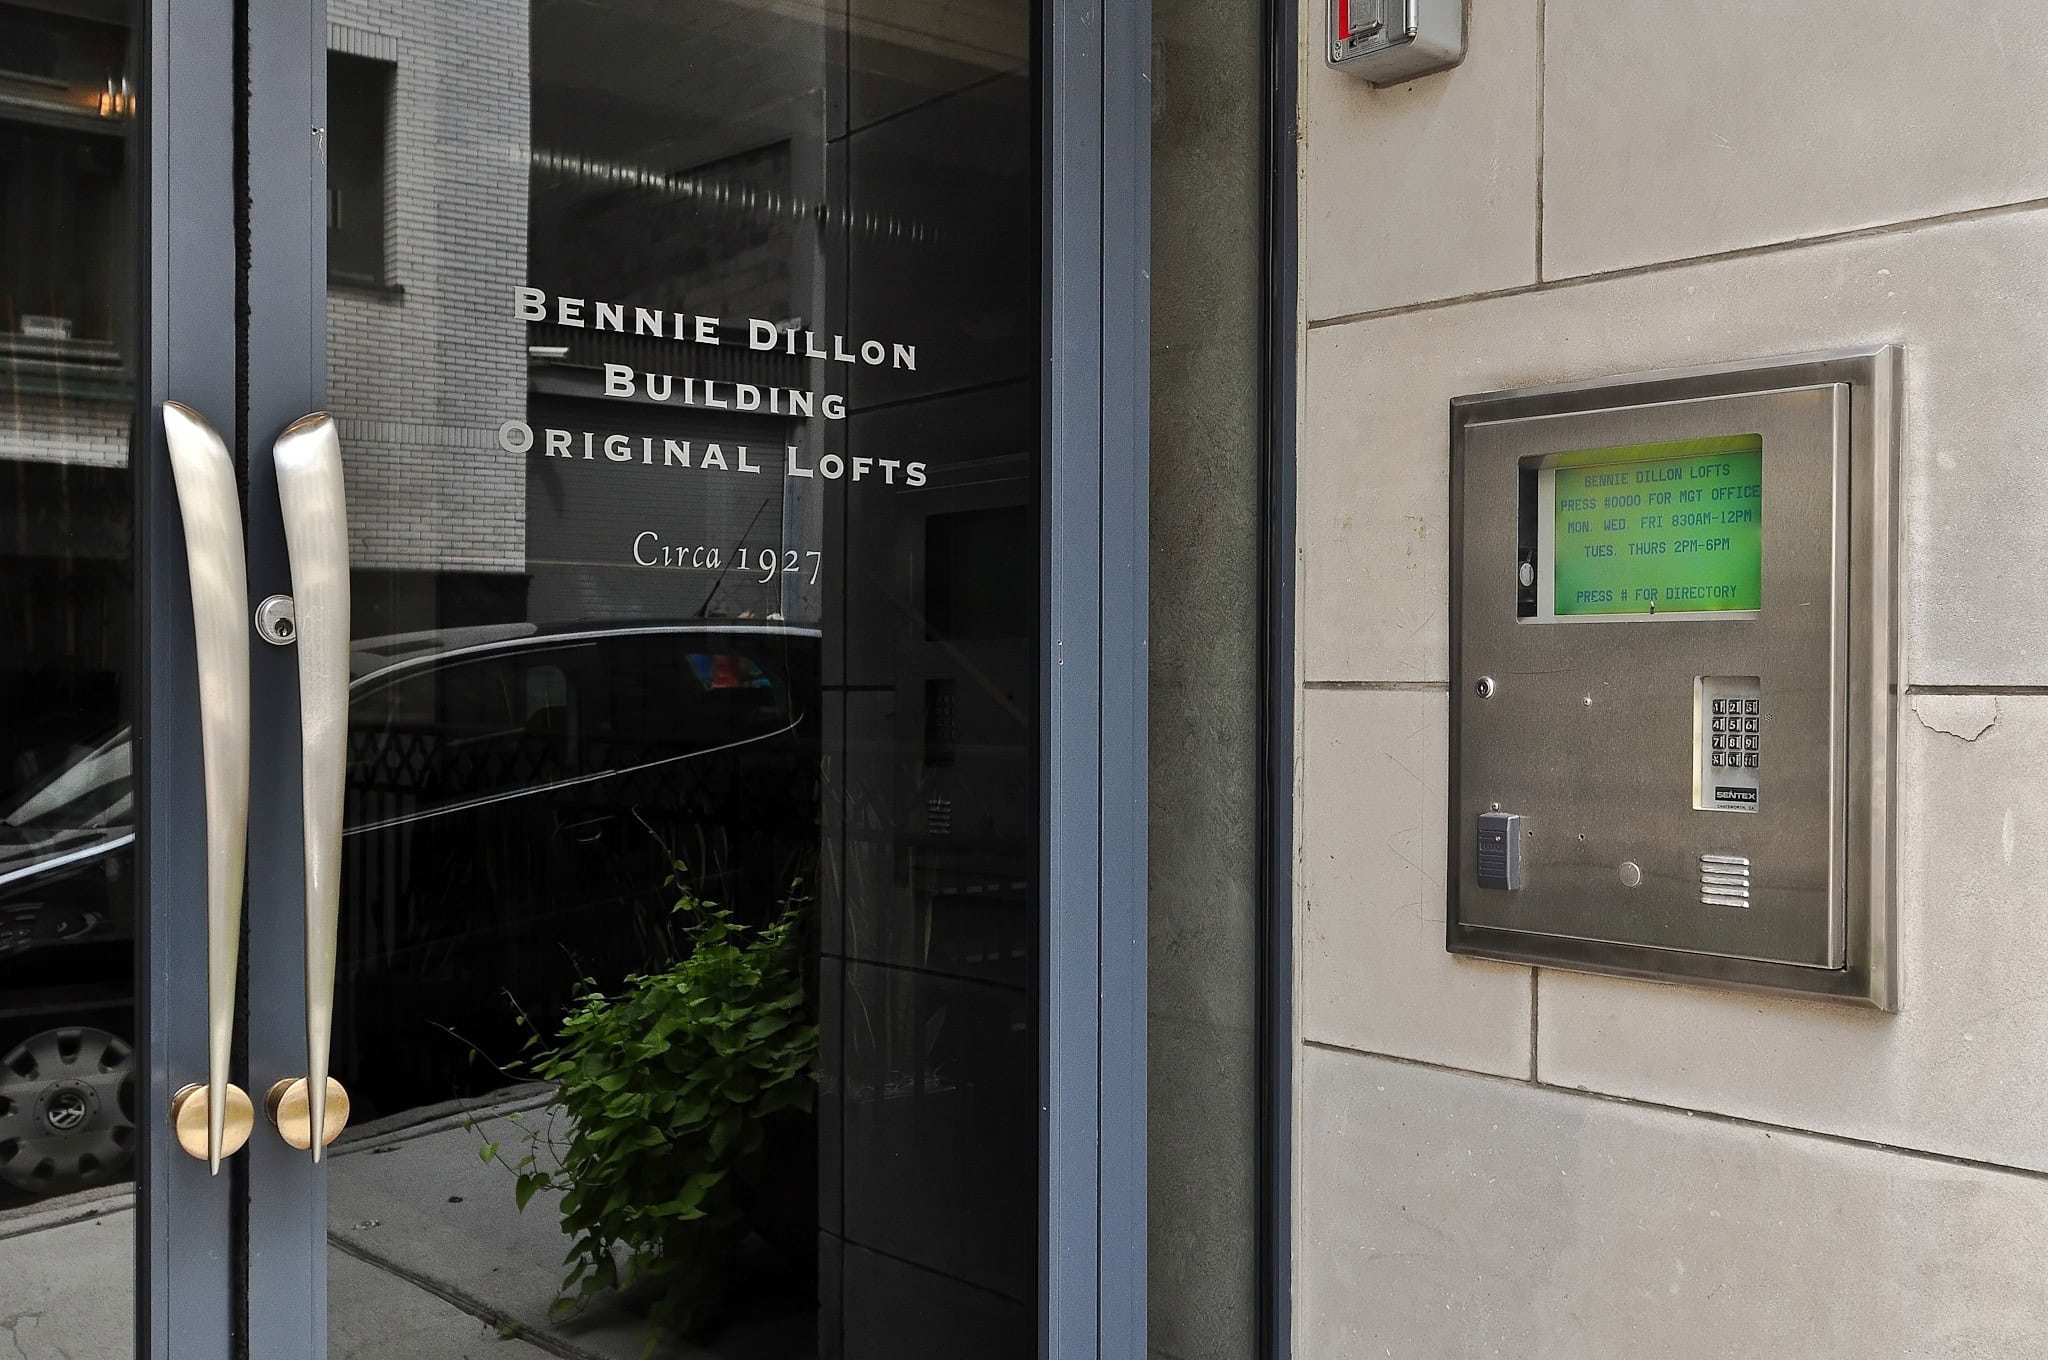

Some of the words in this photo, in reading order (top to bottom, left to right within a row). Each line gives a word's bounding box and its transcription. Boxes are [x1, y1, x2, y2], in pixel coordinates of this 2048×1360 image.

[513, 285, 720, 346] BENNIE
[748, 318, 917, 370] DILLON
[603, 362, 847, 420] BUILDING
[499, 420, 761, 475] ORIGINAL
[787, 445, 928, 487] LOFTS
[1584, 472, 1629, 488] BENNIE
[1636, 468, 1683, 484] DILLON
[1690, 464, 1731, 479] LOFTS
[1560, 497, 1597, 512] PRESS
[1649, 492, 1672, 506] FOR
[1679, 489, 1704, 504] MGT
[1711, 484, 1761, 501] OFFICE
[1640, 515, 1664, 529] FRI
[1628, 541, 1666, 556] THURS
[1673, 538, 1730, 553] 2PM-6PM
[632, 530, 722, 571] Circa
[737, 546, 822, 586] 1927
[1576, 588, 1613, 603] PRESS
[1620, 589, 1628, 602] #
[1635, 587, 1658, 602] FOR
[1666, 585, 1738, 601] DIRECTORY
[1729, 703, 1736, 712] 2
[1713, 720, 1719, 729] 4
[1729, 720, 1736, 730] 5
[1745, 721, 1752, 730] 6
[1713, 737, 1719, 747] 7
[1729, 738, 1736, 747] 8
[1745, 738, 1752, 748] 9
[1716, 790, 1756, 800] SENTEX
